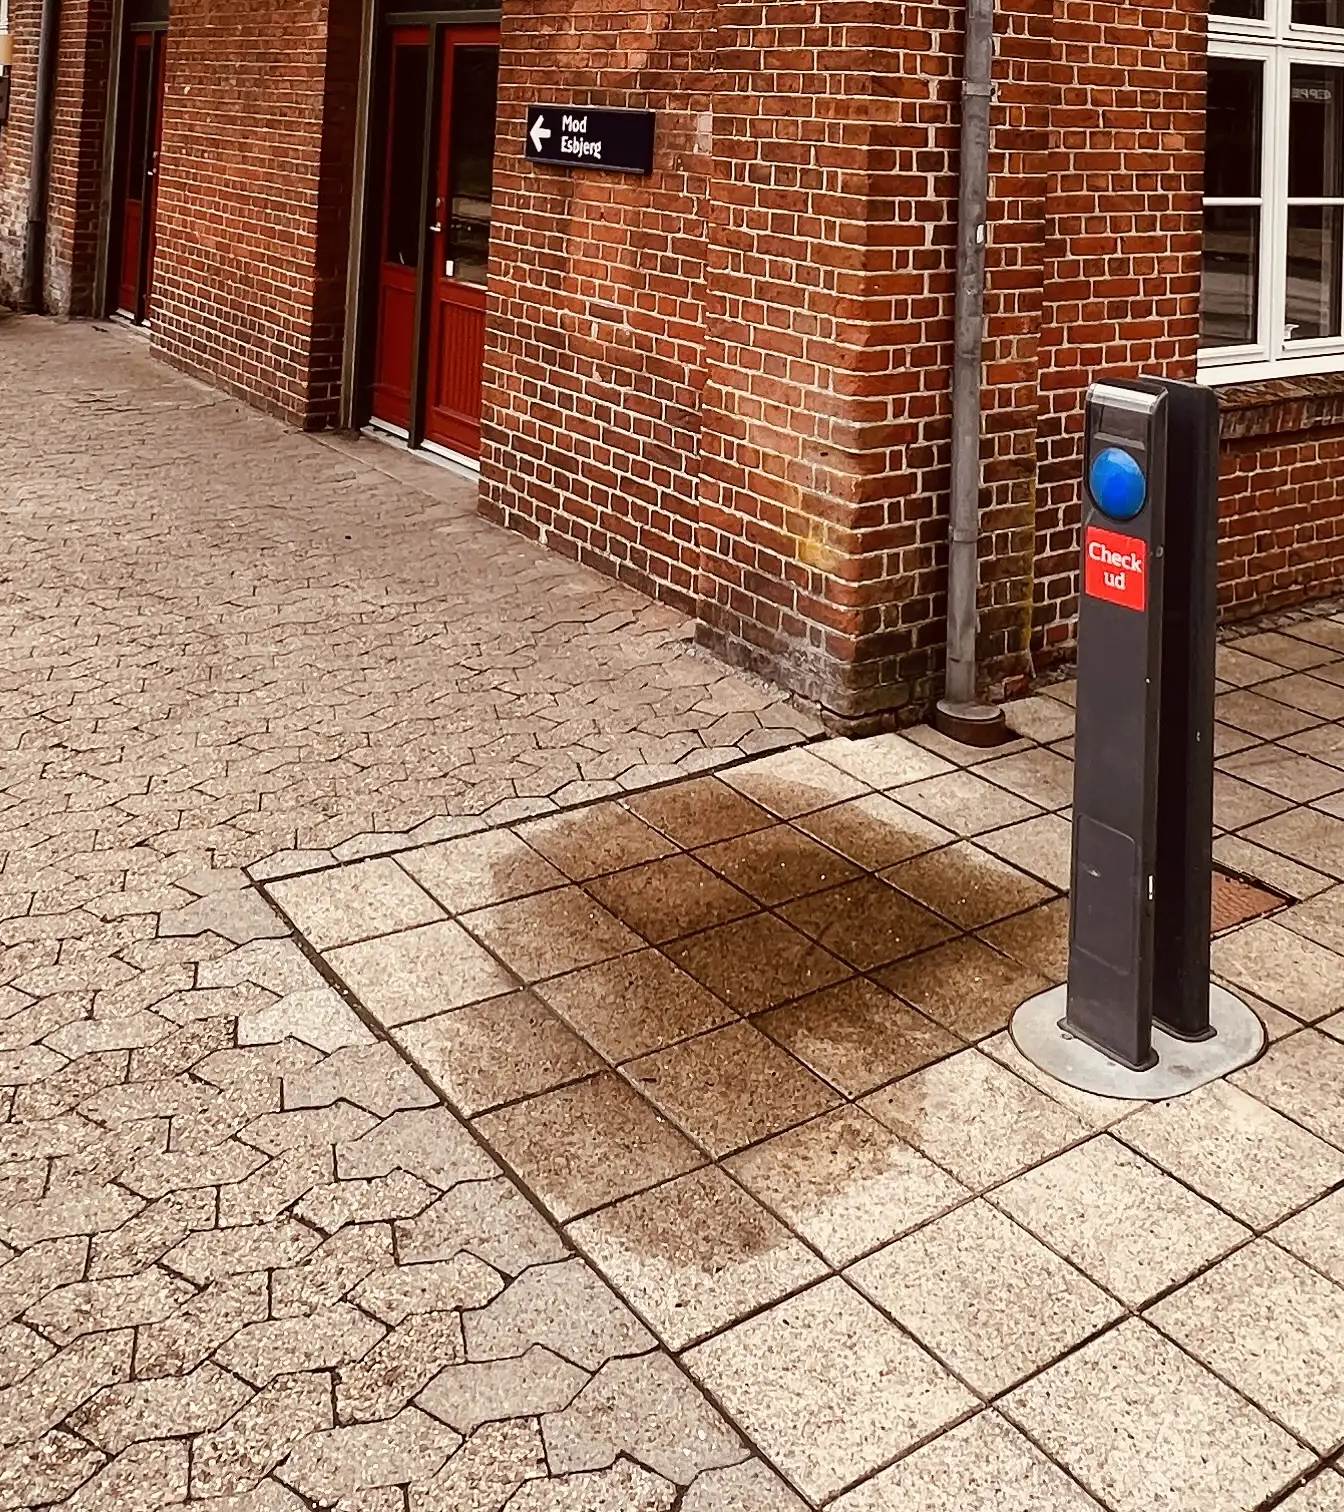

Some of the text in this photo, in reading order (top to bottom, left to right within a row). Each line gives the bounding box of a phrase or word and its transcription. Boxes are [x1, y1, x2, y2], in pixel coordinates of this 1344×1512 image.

[561, 114, 588, 133] Mod
[560, 135, 602, 160] Esbjerg
[1088, 541, 1143, 573] Check
[1103, 571, 1126, 591] ud
